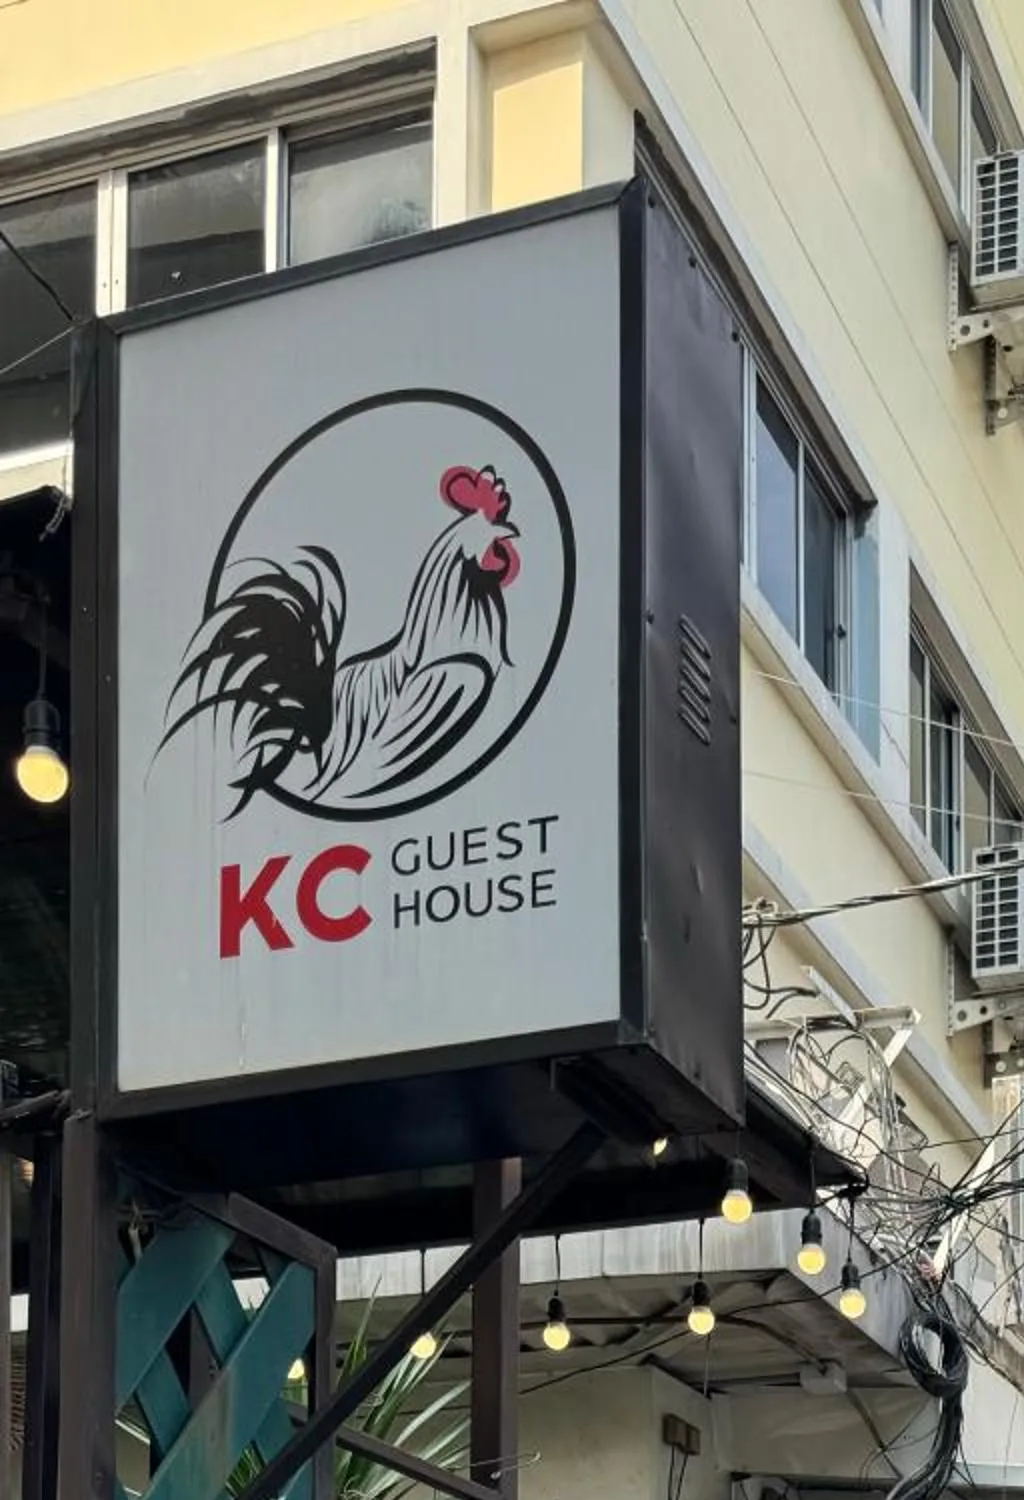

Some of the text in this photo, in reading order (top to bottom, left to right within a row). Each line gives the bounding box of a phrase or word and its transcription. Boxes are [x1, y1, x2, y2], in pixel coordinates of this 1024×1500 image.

[391, 815, 560, 877] GUEST
[219, 843, 373, 961] KC
[393, 868, 558, 929] HOUSE
